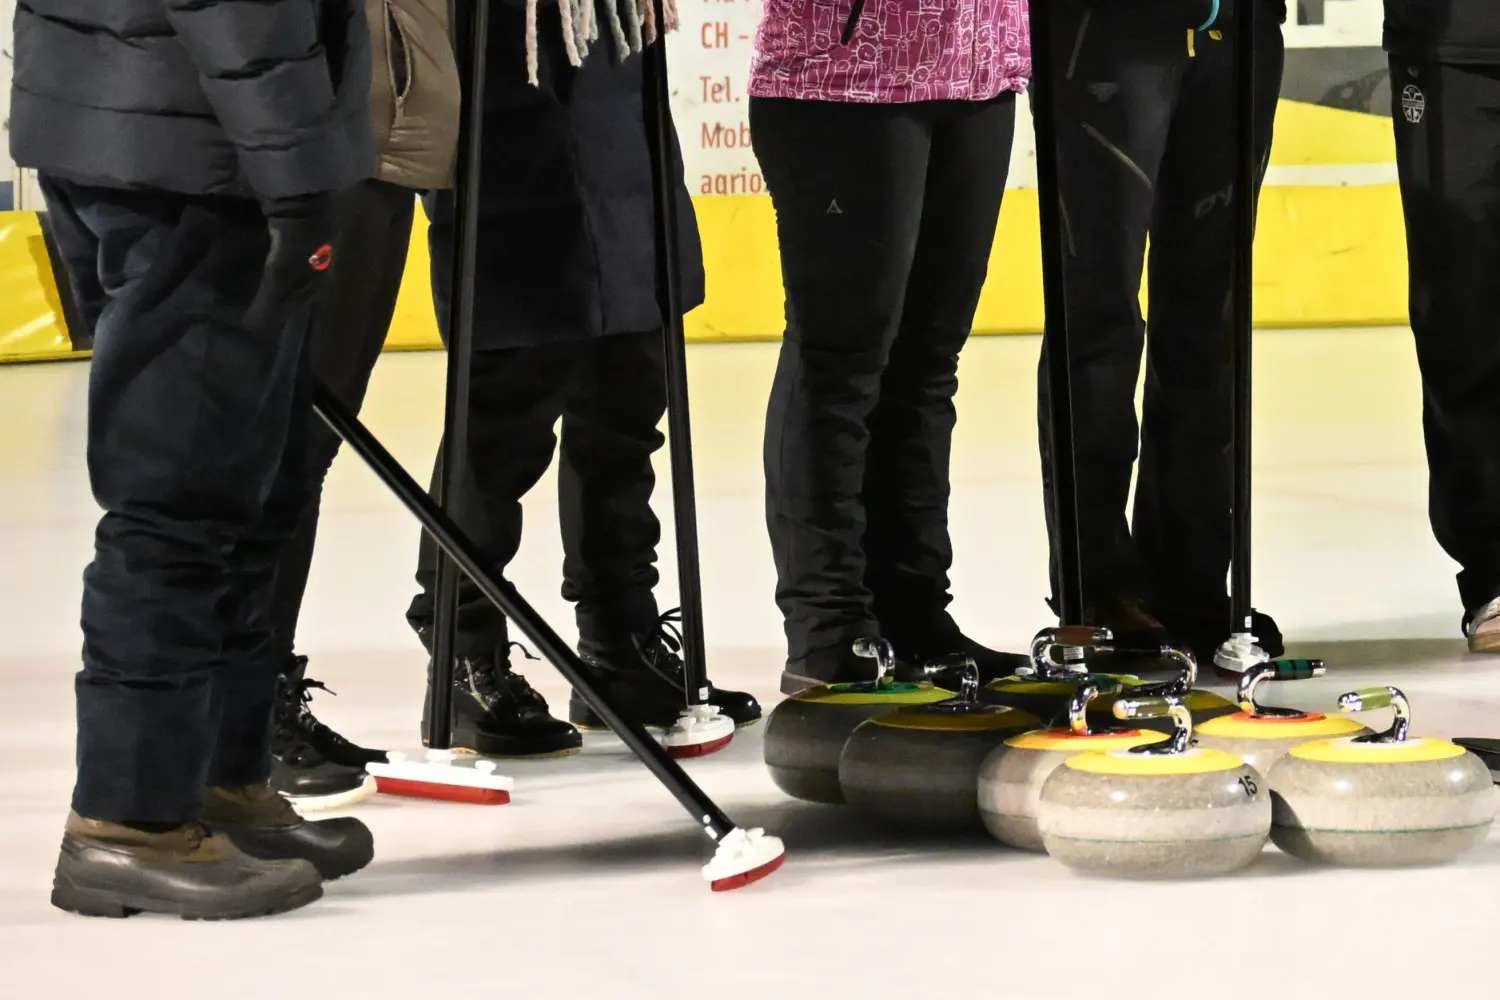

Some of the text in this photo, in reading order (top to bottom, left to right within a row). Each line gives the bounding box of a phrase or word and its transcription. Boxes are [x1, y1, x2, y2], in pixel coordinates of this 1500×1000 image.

[701, 22, 728, 49] CH
[699, 76, 740, 103] Tel.
[701, 166, 767, 195] agrio
[1238, 775, 1258, 796] 15
